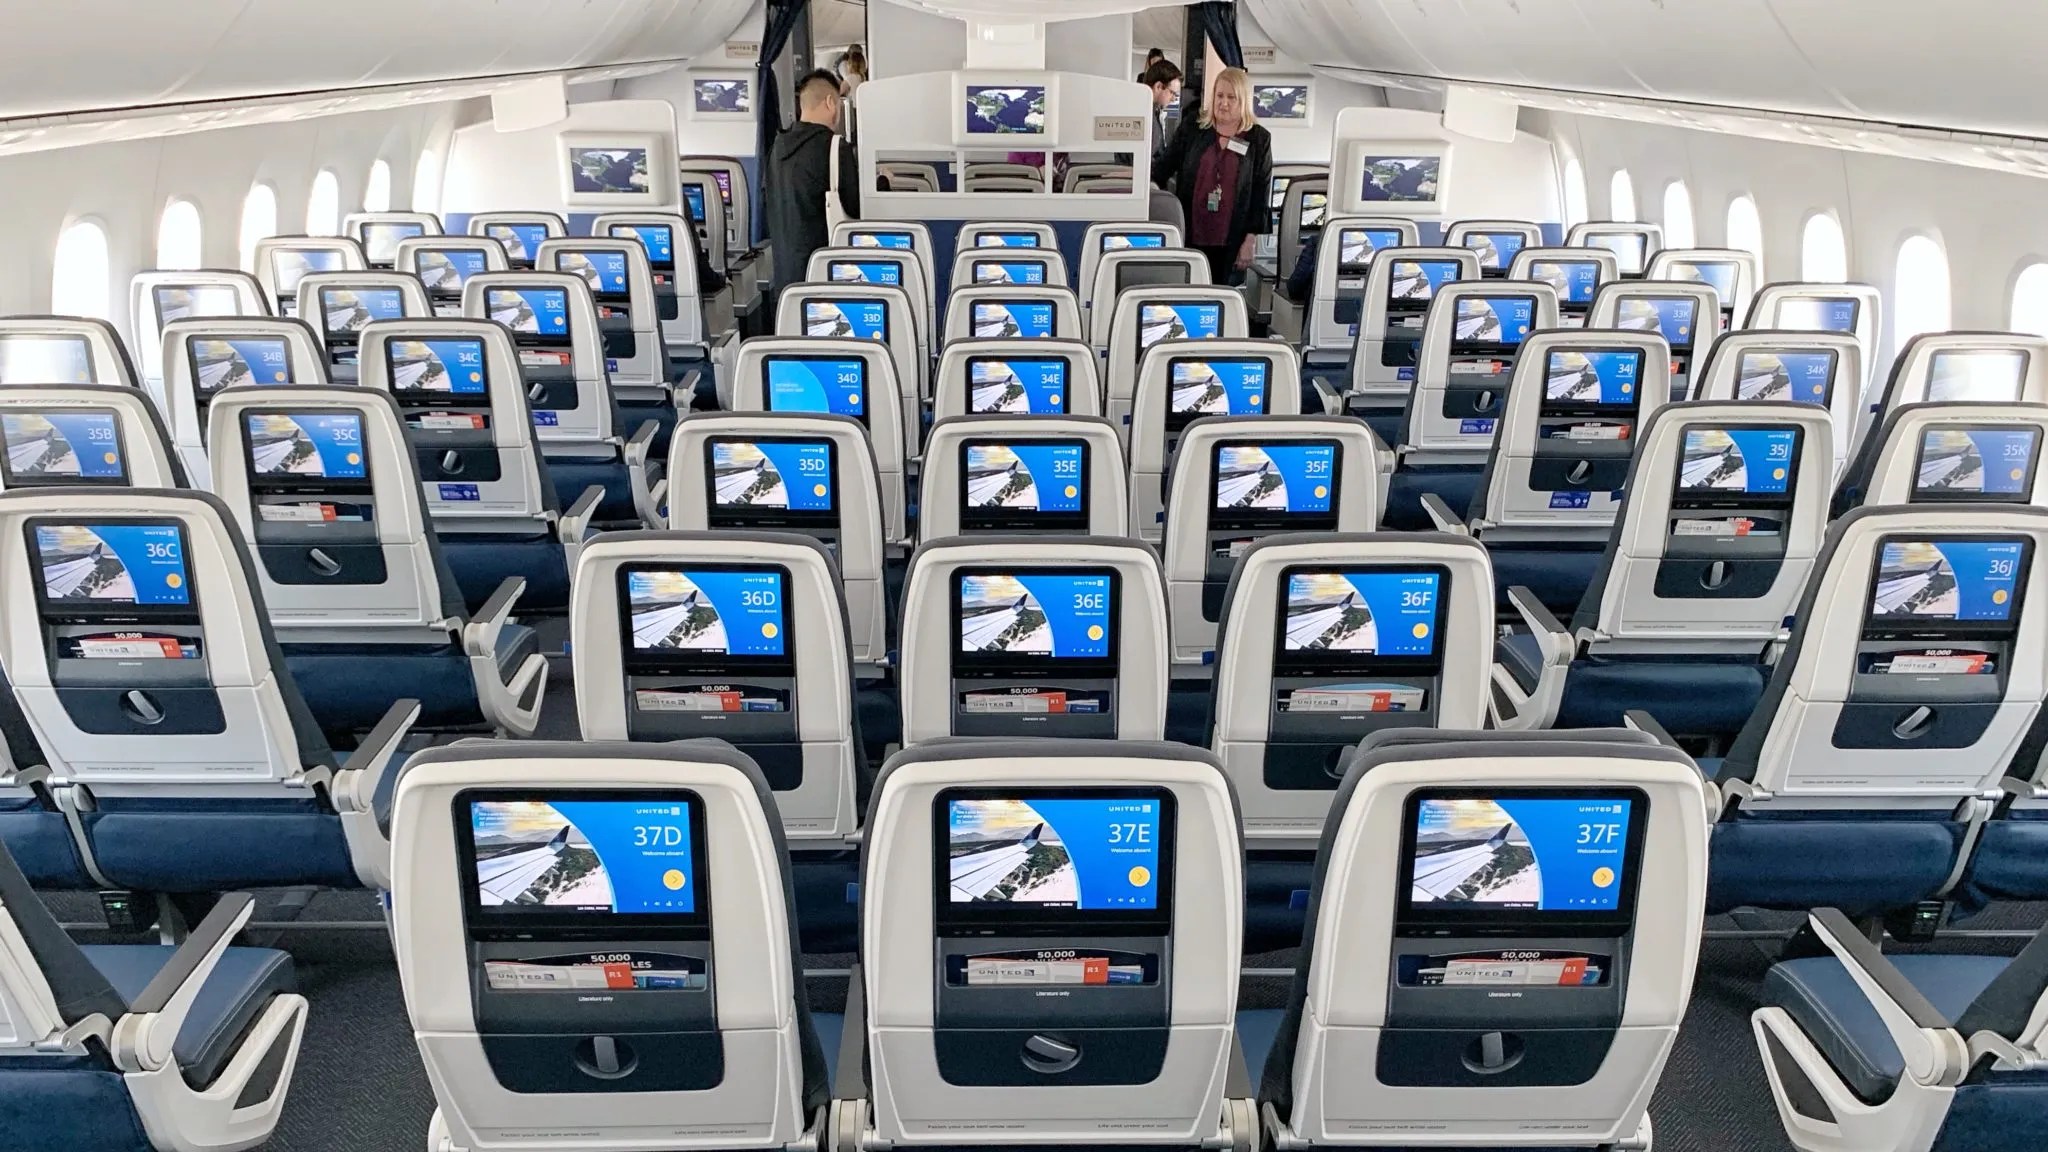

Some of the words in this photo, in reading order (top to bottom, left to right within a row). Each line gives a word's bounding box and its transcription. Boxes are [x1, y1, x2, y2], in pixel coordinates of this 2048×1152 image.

[655, 234, 667, 242] 31C
[467, 260, 482, 268] 32B
[608, 261, 622, 270] 32C
[881, 273, 896, 282] 32D
[1025, 272, 1039, 281] 32E
[1443, 271, 1454, 280] 32J
[1579, 272, 1593, 280] 32K
[382, 300, 398, 309] 33B
[545, 300, 563, 309] 33C
[863, 313, 881, 323] 33D
[1032, 314, 1048, 324] 33E
[1515, 309, 1528, 319] 33J
[1673, 310, 1689, 318] 33K
[1200, 315, 1216, 325] 33F
[263, 352, 282, 361] 34B
[458, 353, 479, 363] 34C
[1618, 363, 1633, 375] 34J
[1806, 365, 1826, 375] 34K
[837, 373, 858, 383] 34D
[1041, 373, 1060, 384] 34E
[1242, 374, 1262, 385] 34F
[88, 428, 112, 440] 35B
[332, 429, 357, 440] 35C
[1769, 444, 1788, 457] 35J
[2003, 444, 2026, 456] 35K
[799, 458, 825, 471] 35D
[1053, 460, 1077, 473] 35E
[1305, 461, 1328, 473] 35F
[146, 543, 177, 558] 36C
[1988, 559, 2013, 577] 36J
[741, 591, 775, 606] 36D
[1073, 594, 1104, 609] 36E
[1401, 591, 1432, 606] 36F
[633, 826, 682, 847] 37D
[1107, 823, 1152, 843] 37E
[1576, 823, 1620, 844] 37F
[591, 954, 631, 962] 50,000
[1037, 951, 1075, 959] 50,000
[1501, 951, 1540, 959] 50,000
